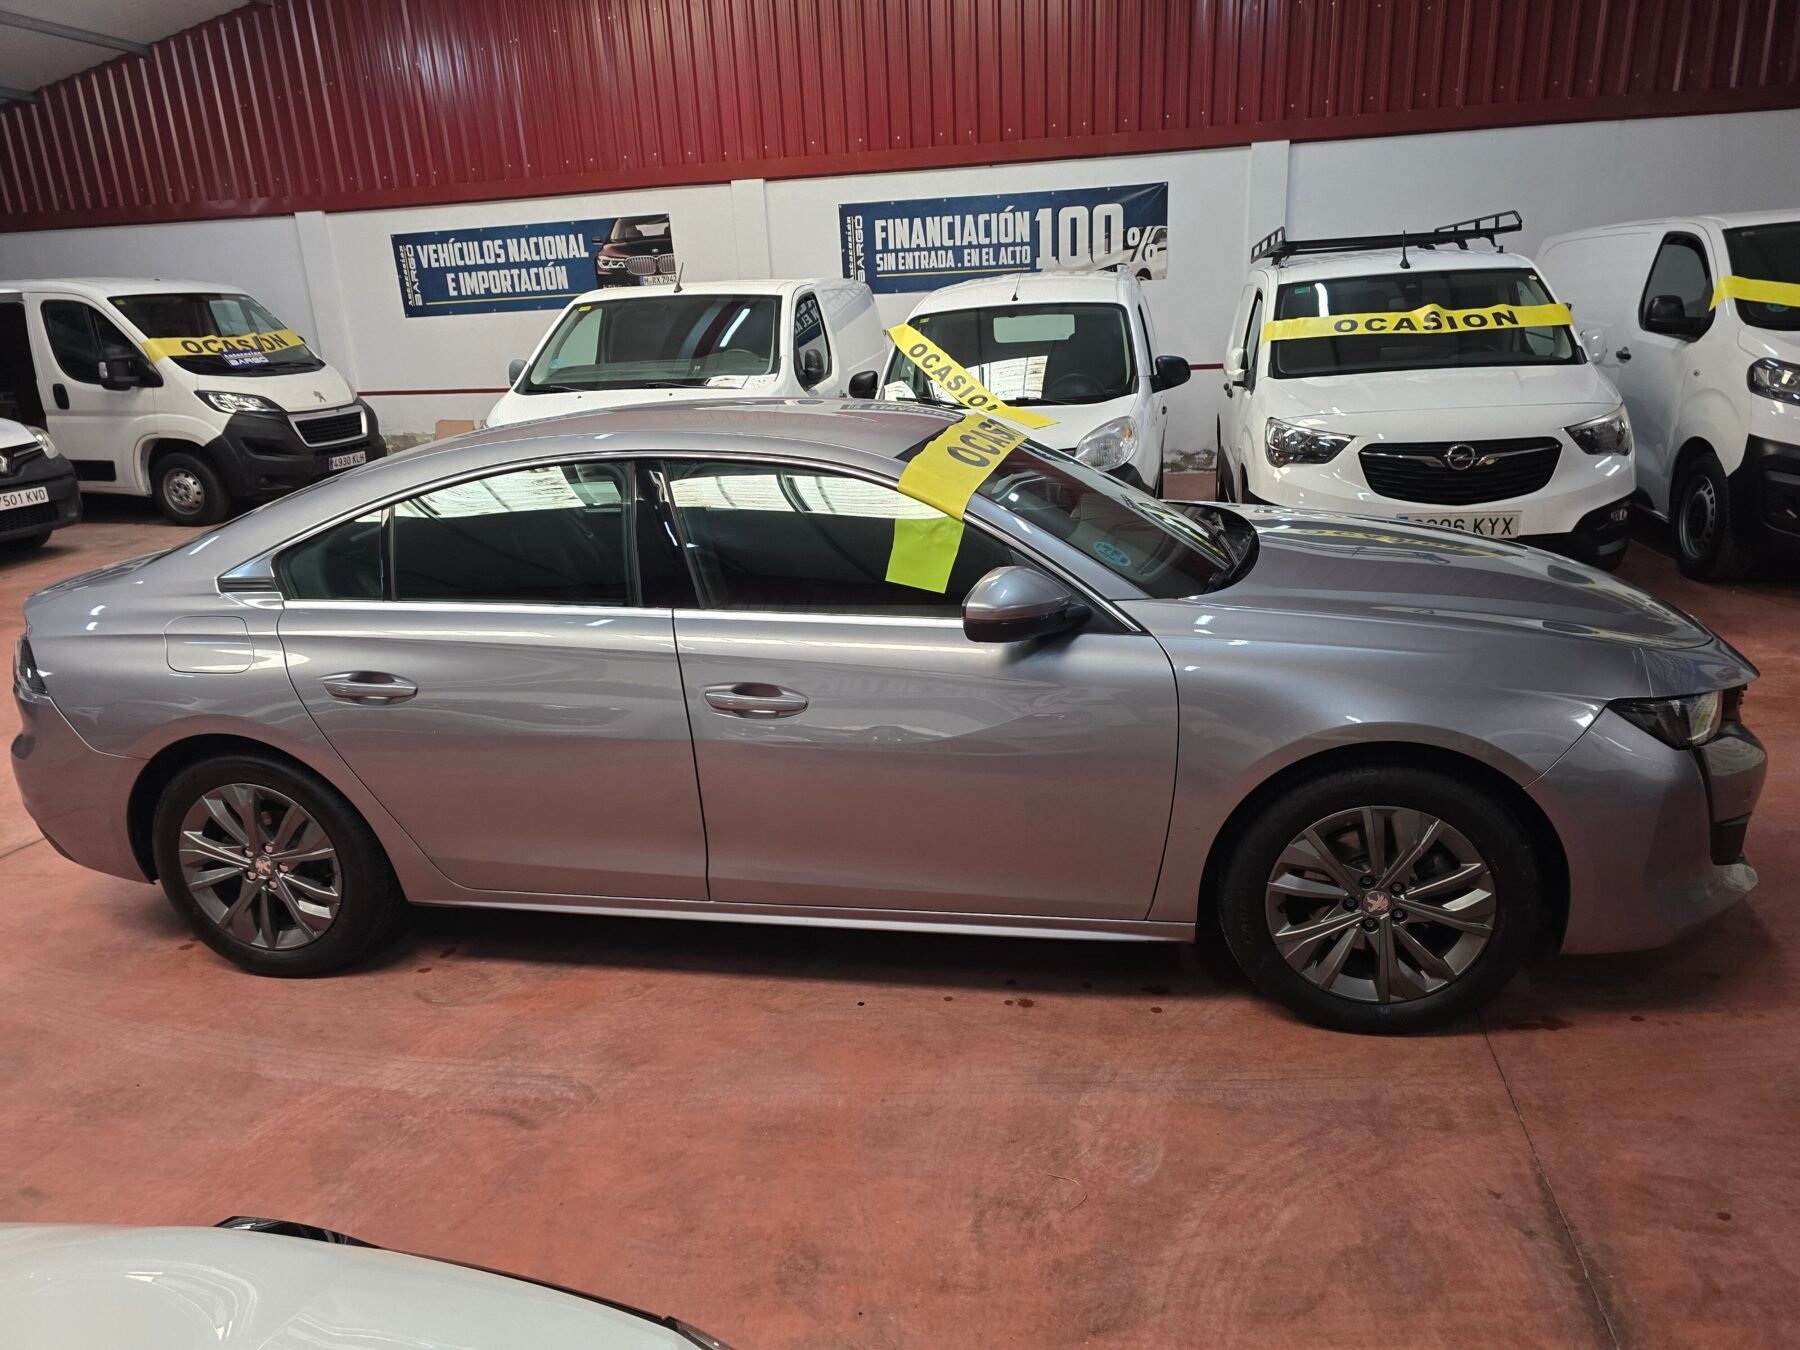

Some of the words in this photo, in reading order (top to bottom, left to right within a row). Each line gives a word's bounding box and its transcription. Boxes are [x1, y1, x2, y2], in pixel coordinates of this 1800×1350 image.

[874, 205, 1030, 250] FINANCIACIÓN
[416, 238, 505, 268] VEHÍCULOS
[507, 233, 589, 263] NACIONAL
[876, 252, 896, 271] SIN
[898, 250, 955, 270] ENTRADA
[964, 248, 981, 267] EN
[982, 247, 996, 266] EL
[997, 245, 1031, 265] ACTO
[446, 272, 458, 296] E
[458, 262, 569, 296] IMPORTACIÓN
[1334, 309, 1519, 332] OCASION
[26, 490, 46, 502] KVD
[1474, 517, 1513, 535] KYX
